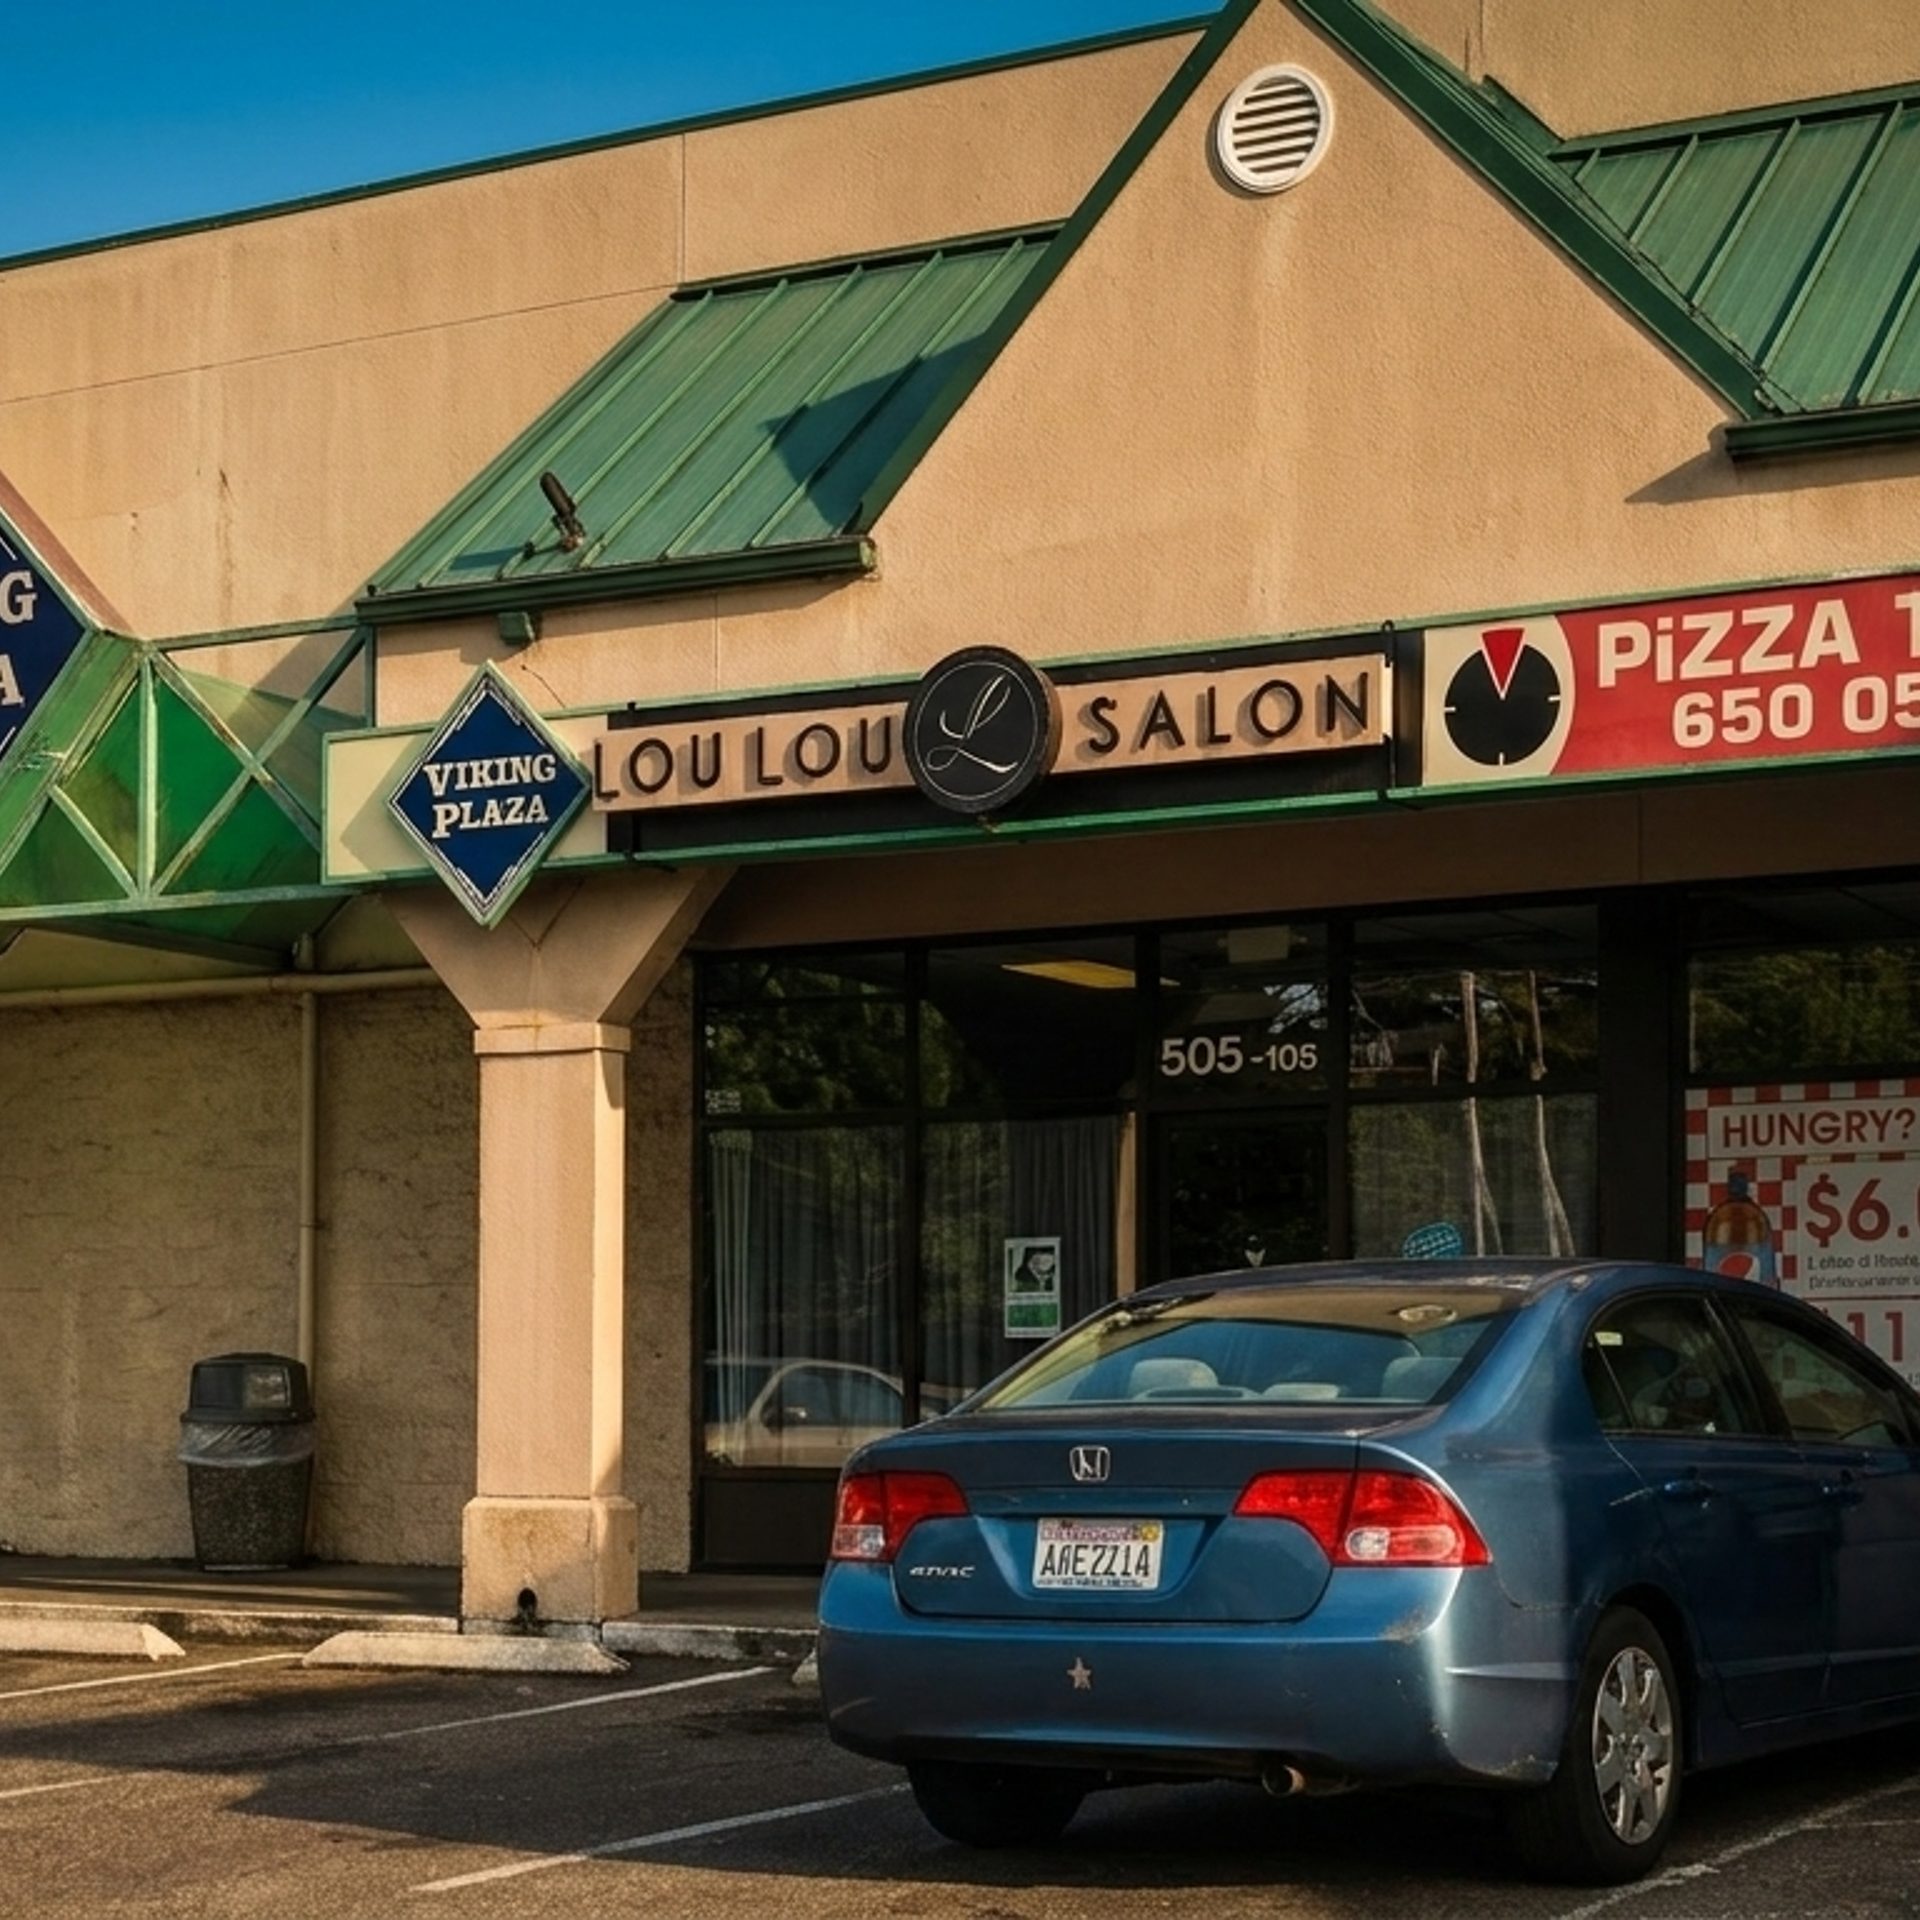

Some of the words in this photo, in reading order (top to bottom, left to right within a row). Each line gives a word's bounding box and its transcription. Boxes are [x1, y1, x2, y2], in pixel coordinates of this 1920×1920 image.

[594, 732, 721, 801] LOU
[757, 716, 891, 785] LOU
[1087, 671, 1369, 754] SALON
[1673, 684, 1814, 749] 650
[423, 754, 556, 796] VIKING
[432, 794, 549, 838] PLAZA
[1723, 1108, 1916, 1148] HUNGRY?
[1806, 1173, 1920, 1248] $6.
